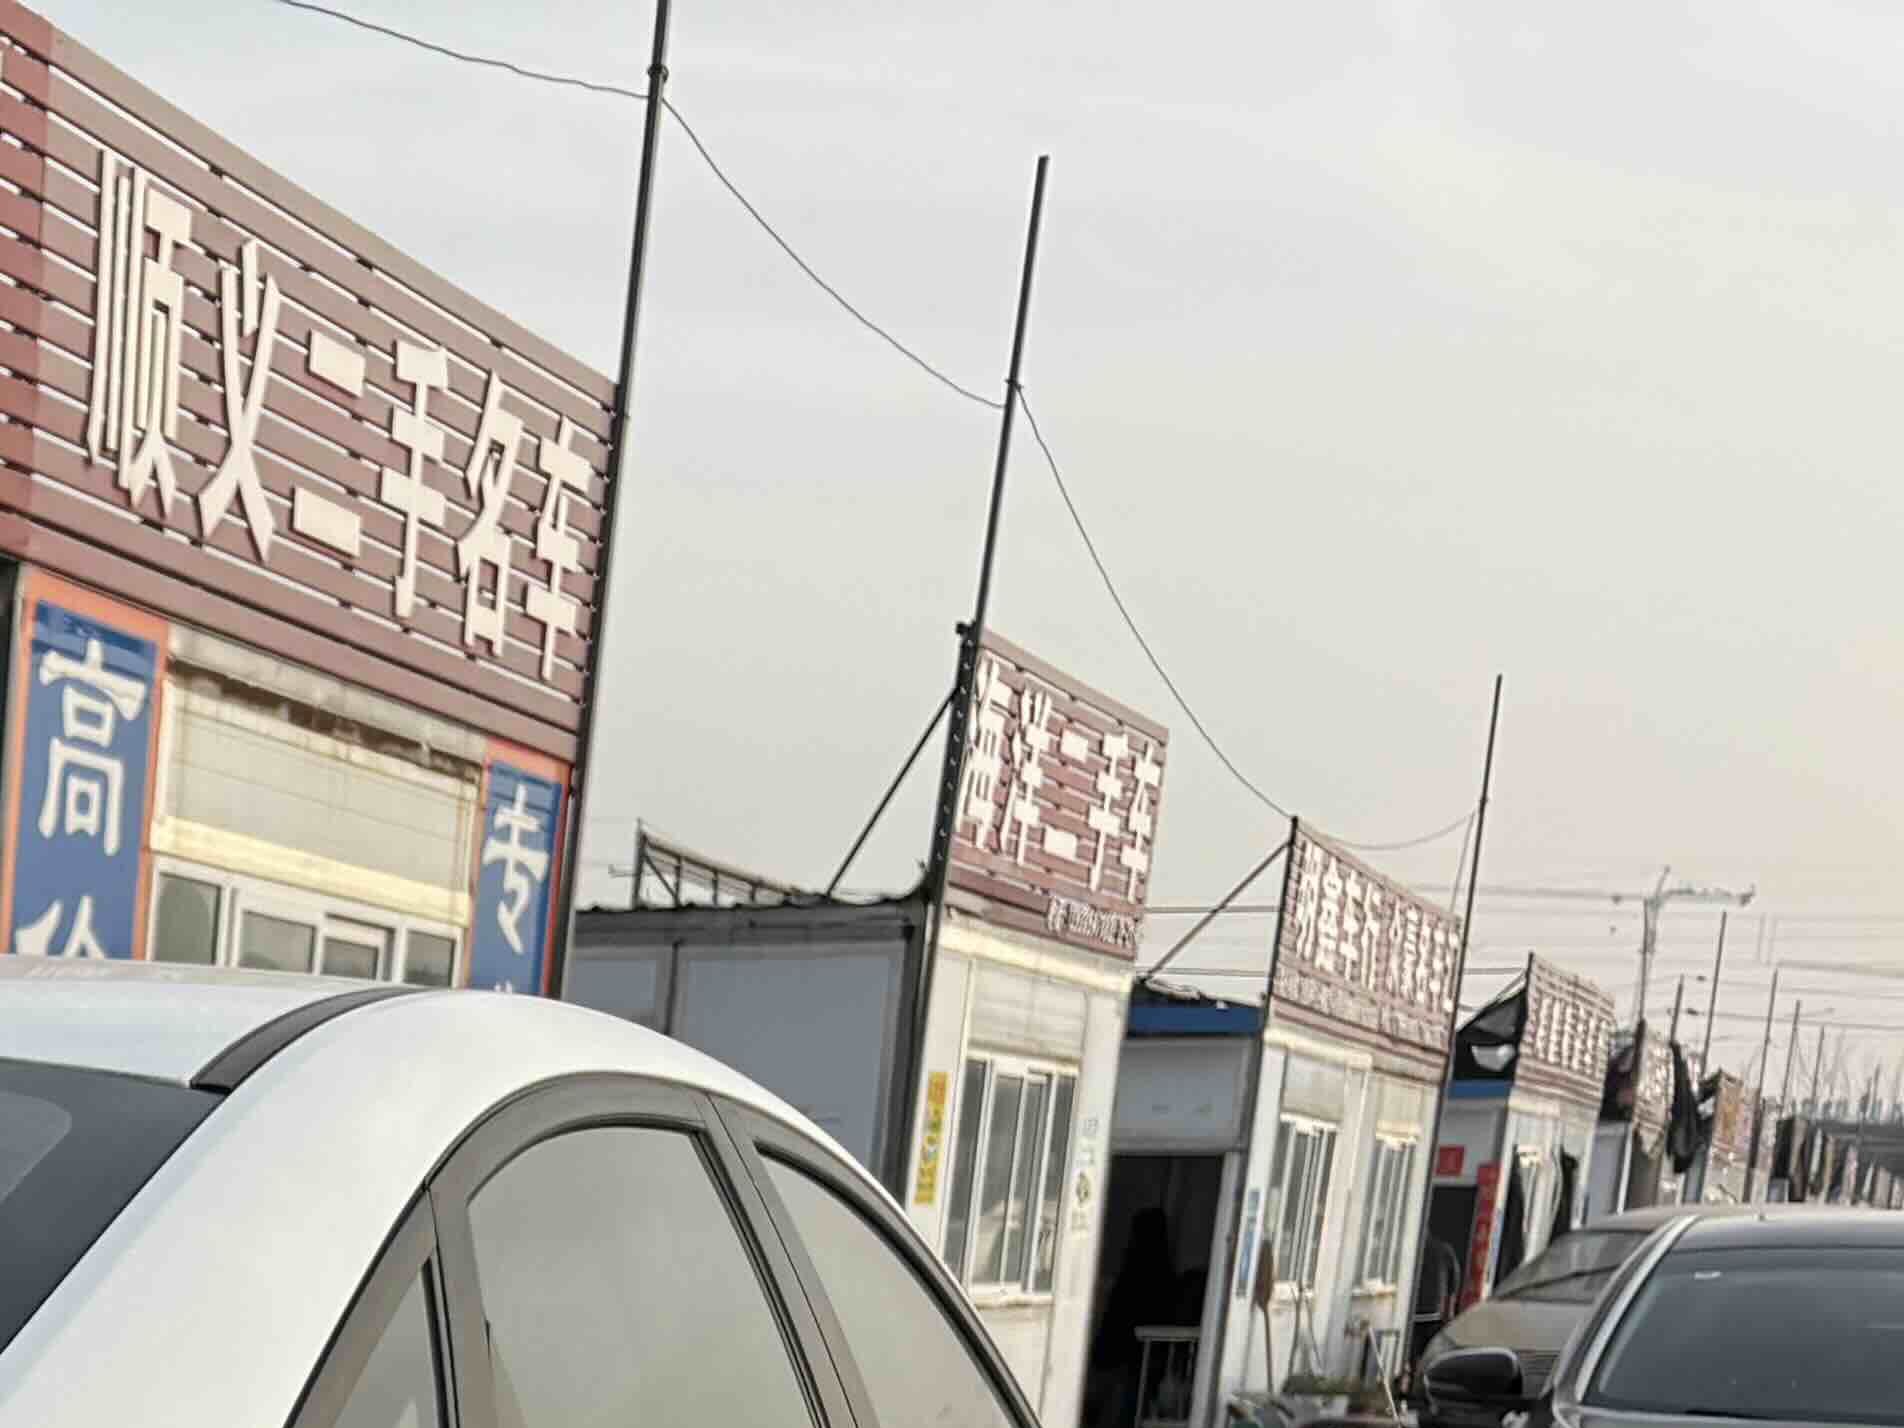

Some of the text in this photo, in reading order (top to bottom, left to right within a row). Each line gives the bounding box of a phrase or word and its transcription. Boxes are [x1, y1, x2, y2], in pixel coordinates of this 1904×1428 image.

[85, 148, 592, 682] 顺义二手名车
[13, 640, 149, 960] 高
